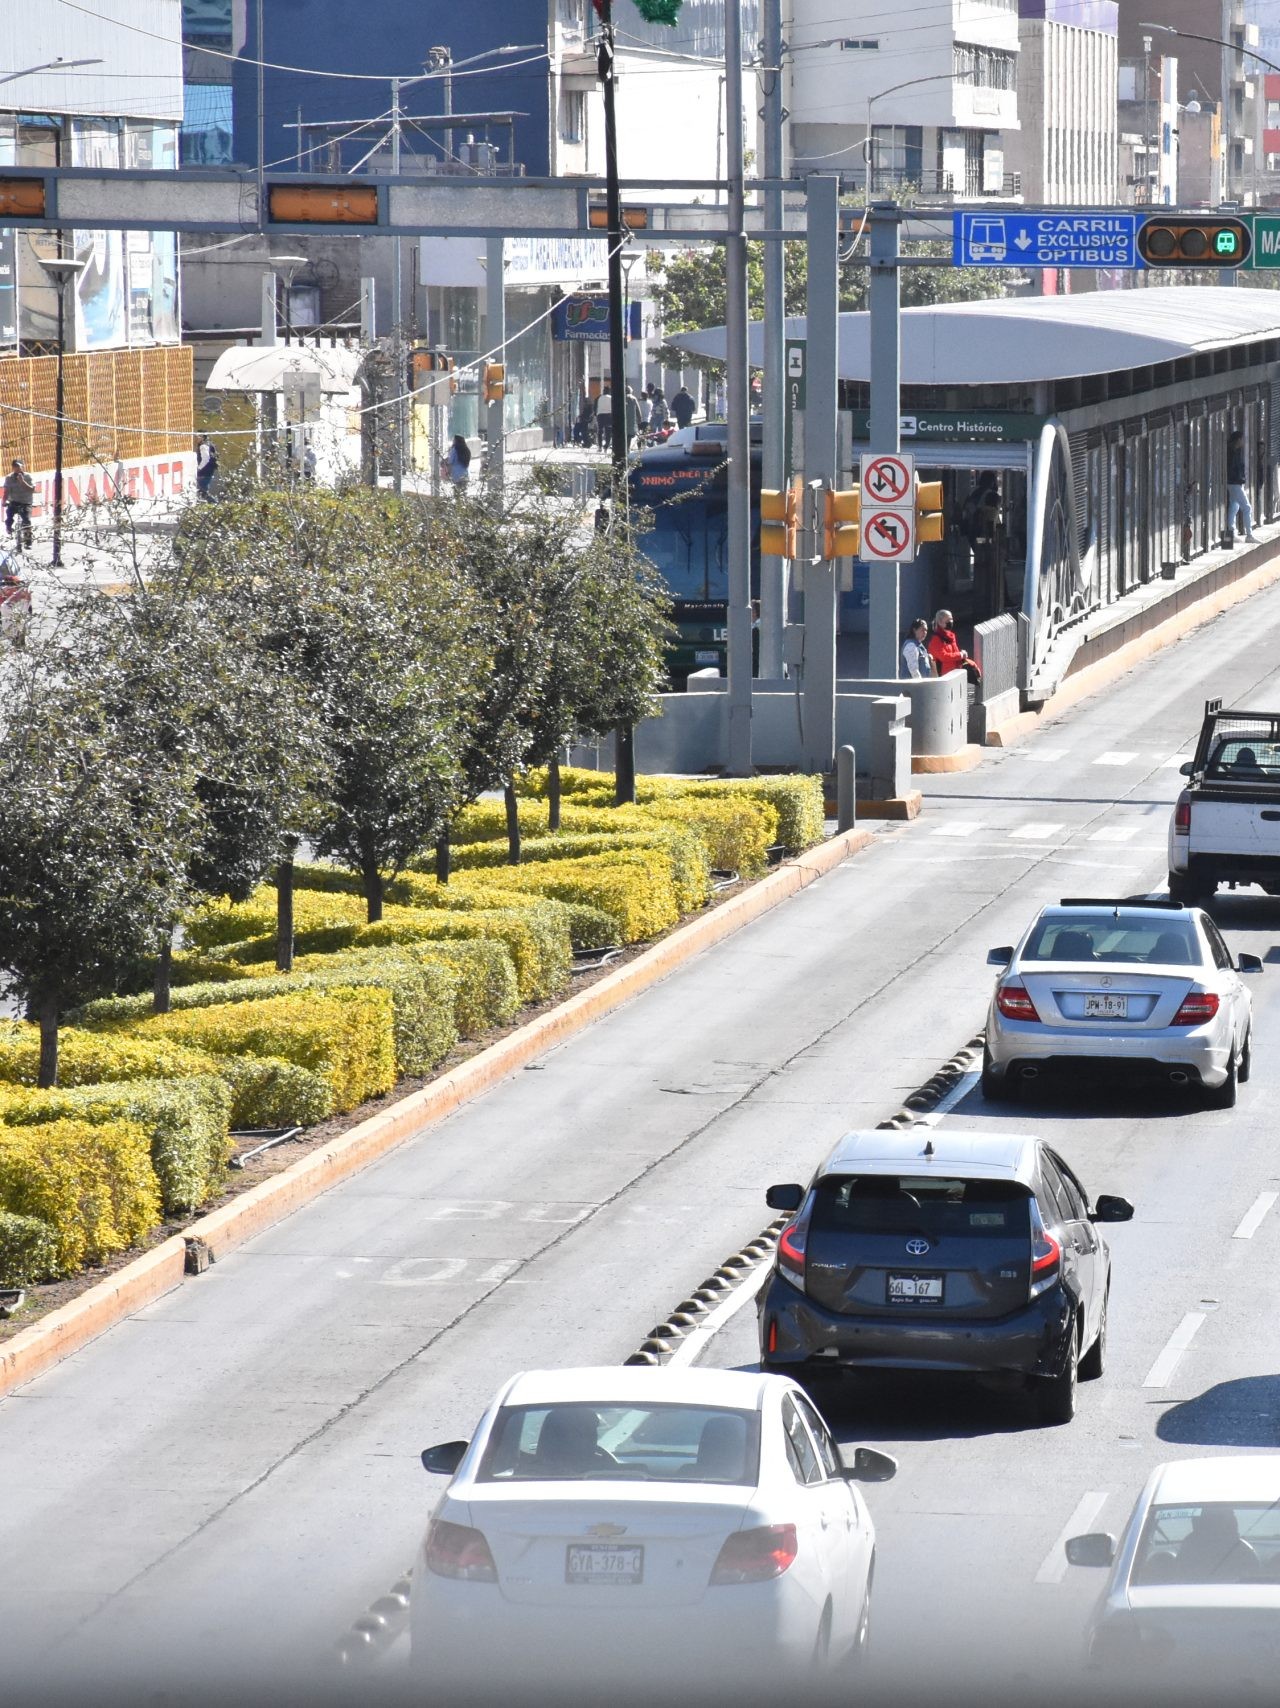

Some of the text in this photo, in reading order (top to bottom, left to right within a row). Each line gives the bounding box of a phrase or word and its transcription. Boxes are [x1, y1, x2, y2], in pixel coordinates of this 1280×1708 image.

[1037, 219, 1129, 233] CARRIL
[1037, 234, 1129, 248] EXCLUSIVO
[1037, 249, 1129, 262] OPTIBUS
[918, 421, 1003, 433] Centro Histórico
[570, 1555, 641, 1571] GYA-378-C
